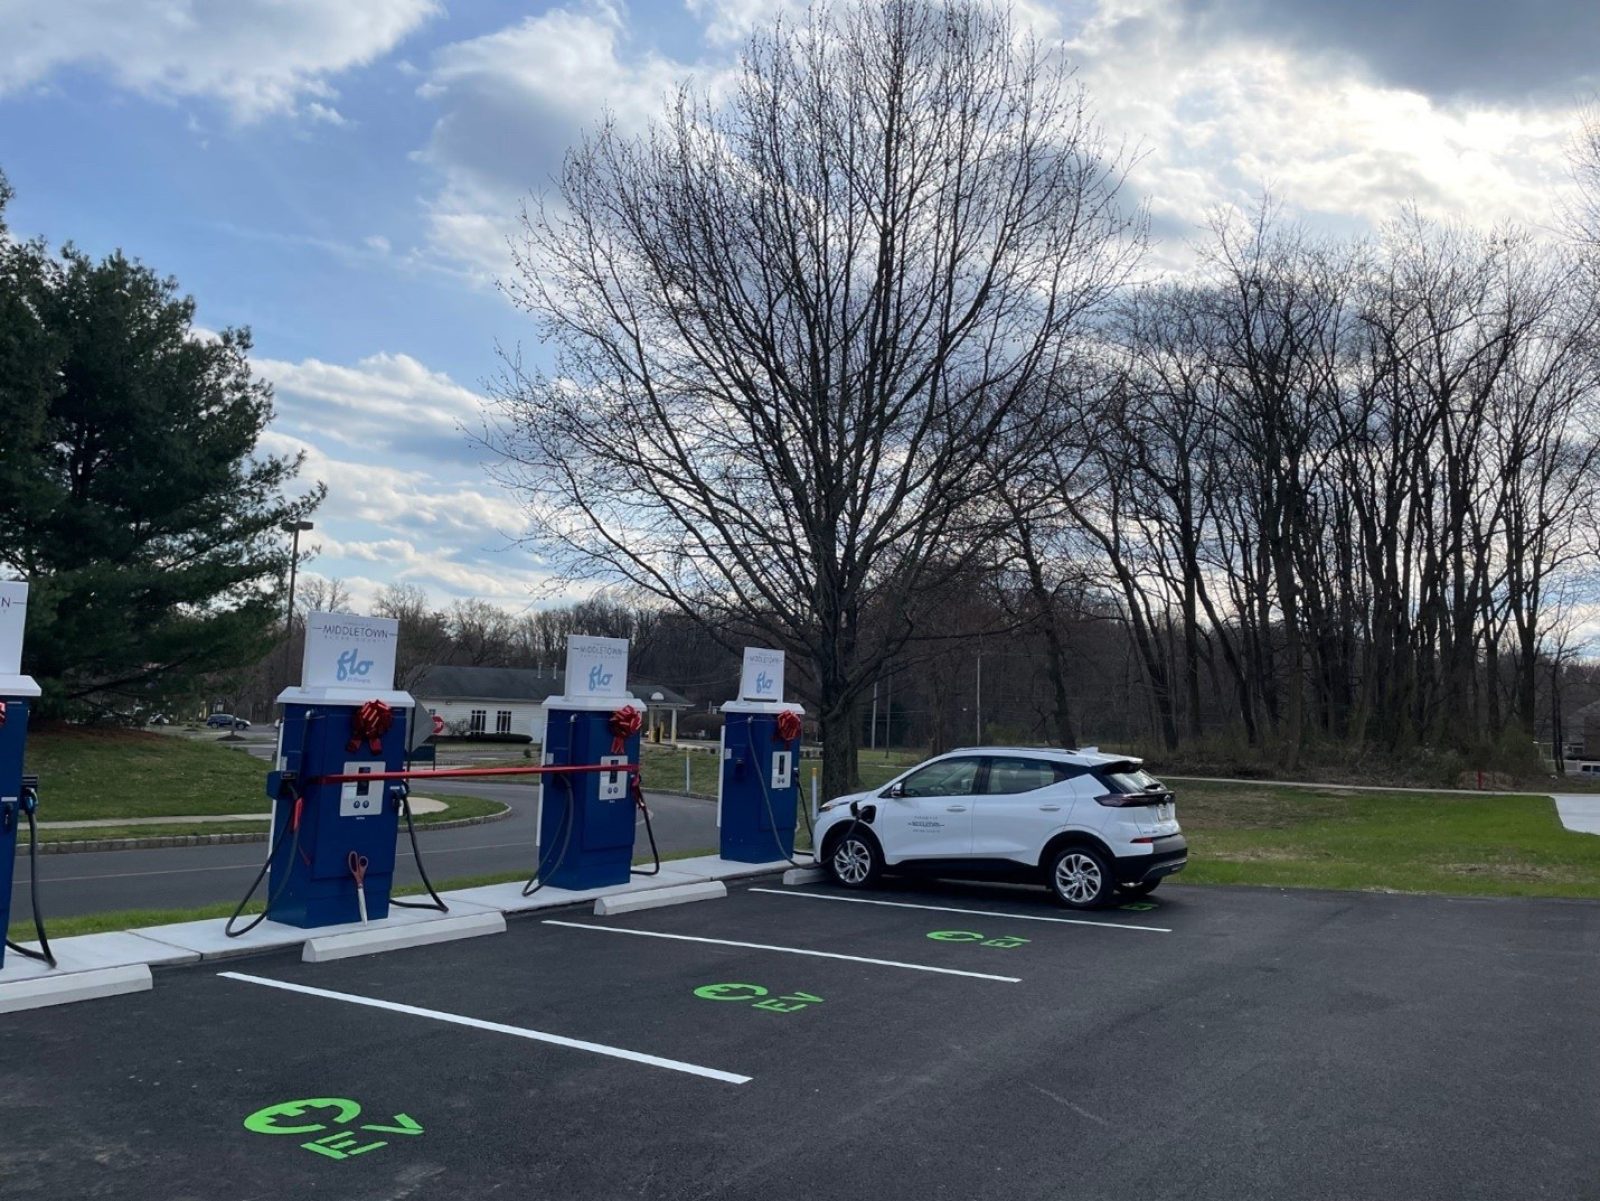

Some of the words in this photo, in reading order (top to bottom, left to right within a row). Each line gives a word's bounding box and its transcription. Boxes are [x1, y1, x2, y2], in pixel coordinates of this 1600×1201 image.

[322, 624, 388, 639] MIDDLETOWN
[336, 647, 374, 681] flo
[589, 663, 613, 691] flo
[756, 671, 774, 694] flo
[751, 991, 824, 1013] EV
[300, 1112, 425, 1160] EV
